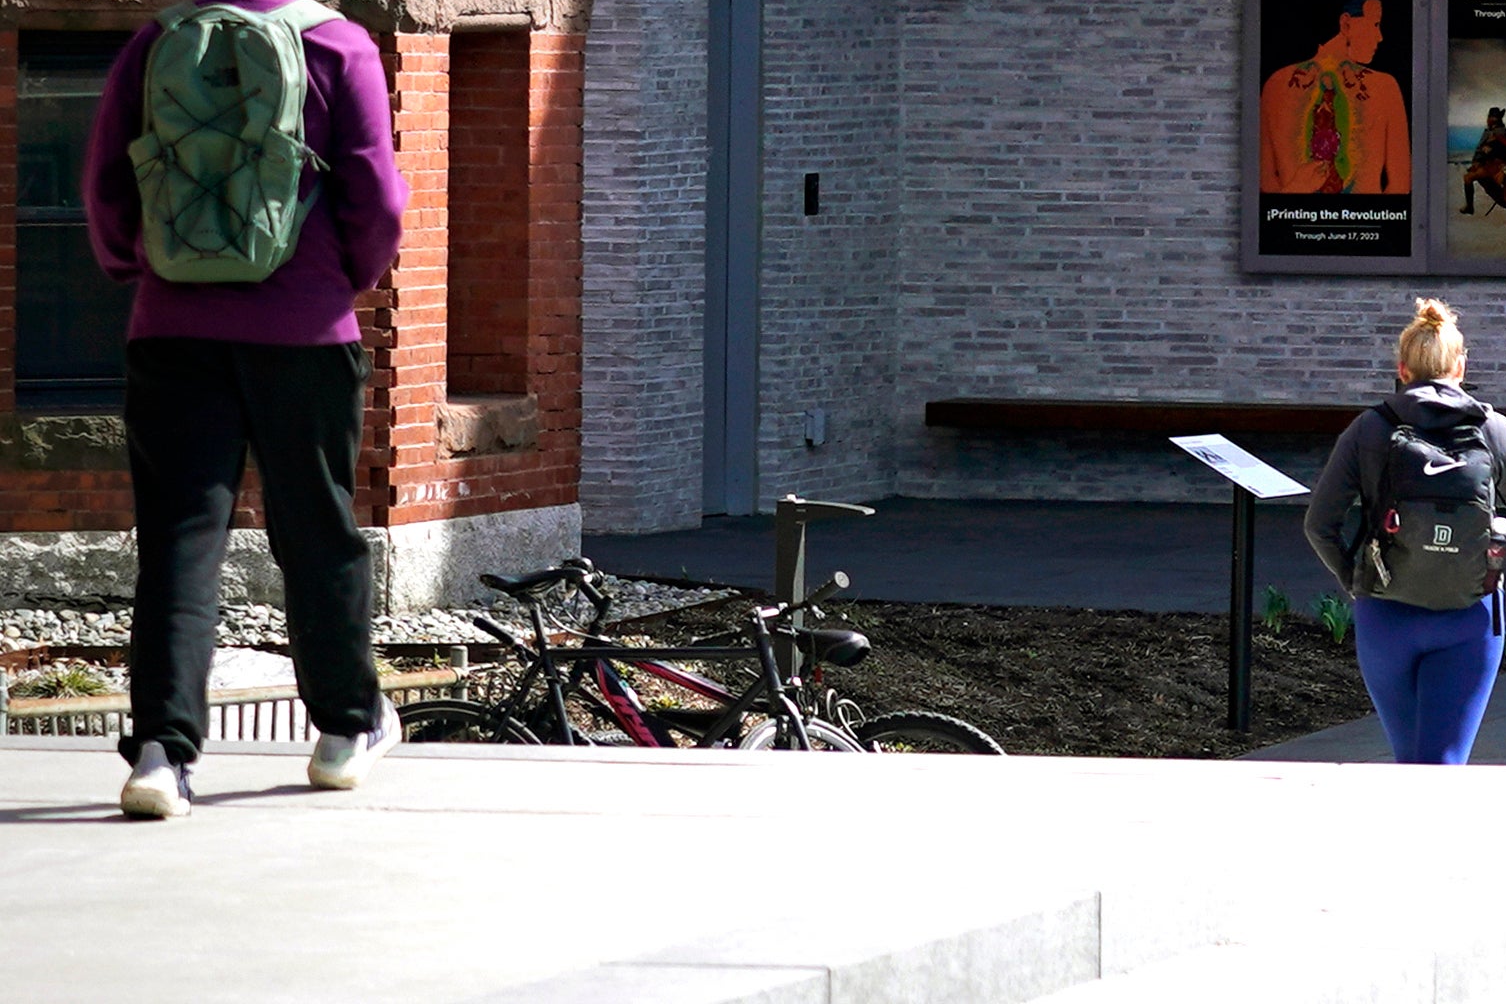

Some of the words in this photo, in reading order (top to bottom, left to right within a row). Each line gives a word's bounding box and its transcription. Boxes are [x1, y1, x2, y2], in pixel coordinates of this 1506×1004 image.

[1473, 9, 1506, 19] Through
[1266, 208, 1318, 222] ¡Printing
[1320, 209, 1340, 220] the
[1341, 209, 1408, 221] Revolution!
[1294, 231, 1327, 241] Through
[1327, 232, 1347, 240] June
[1360, 232, 1380, 240] 2023
[1433, 524, 1452, 545] D
